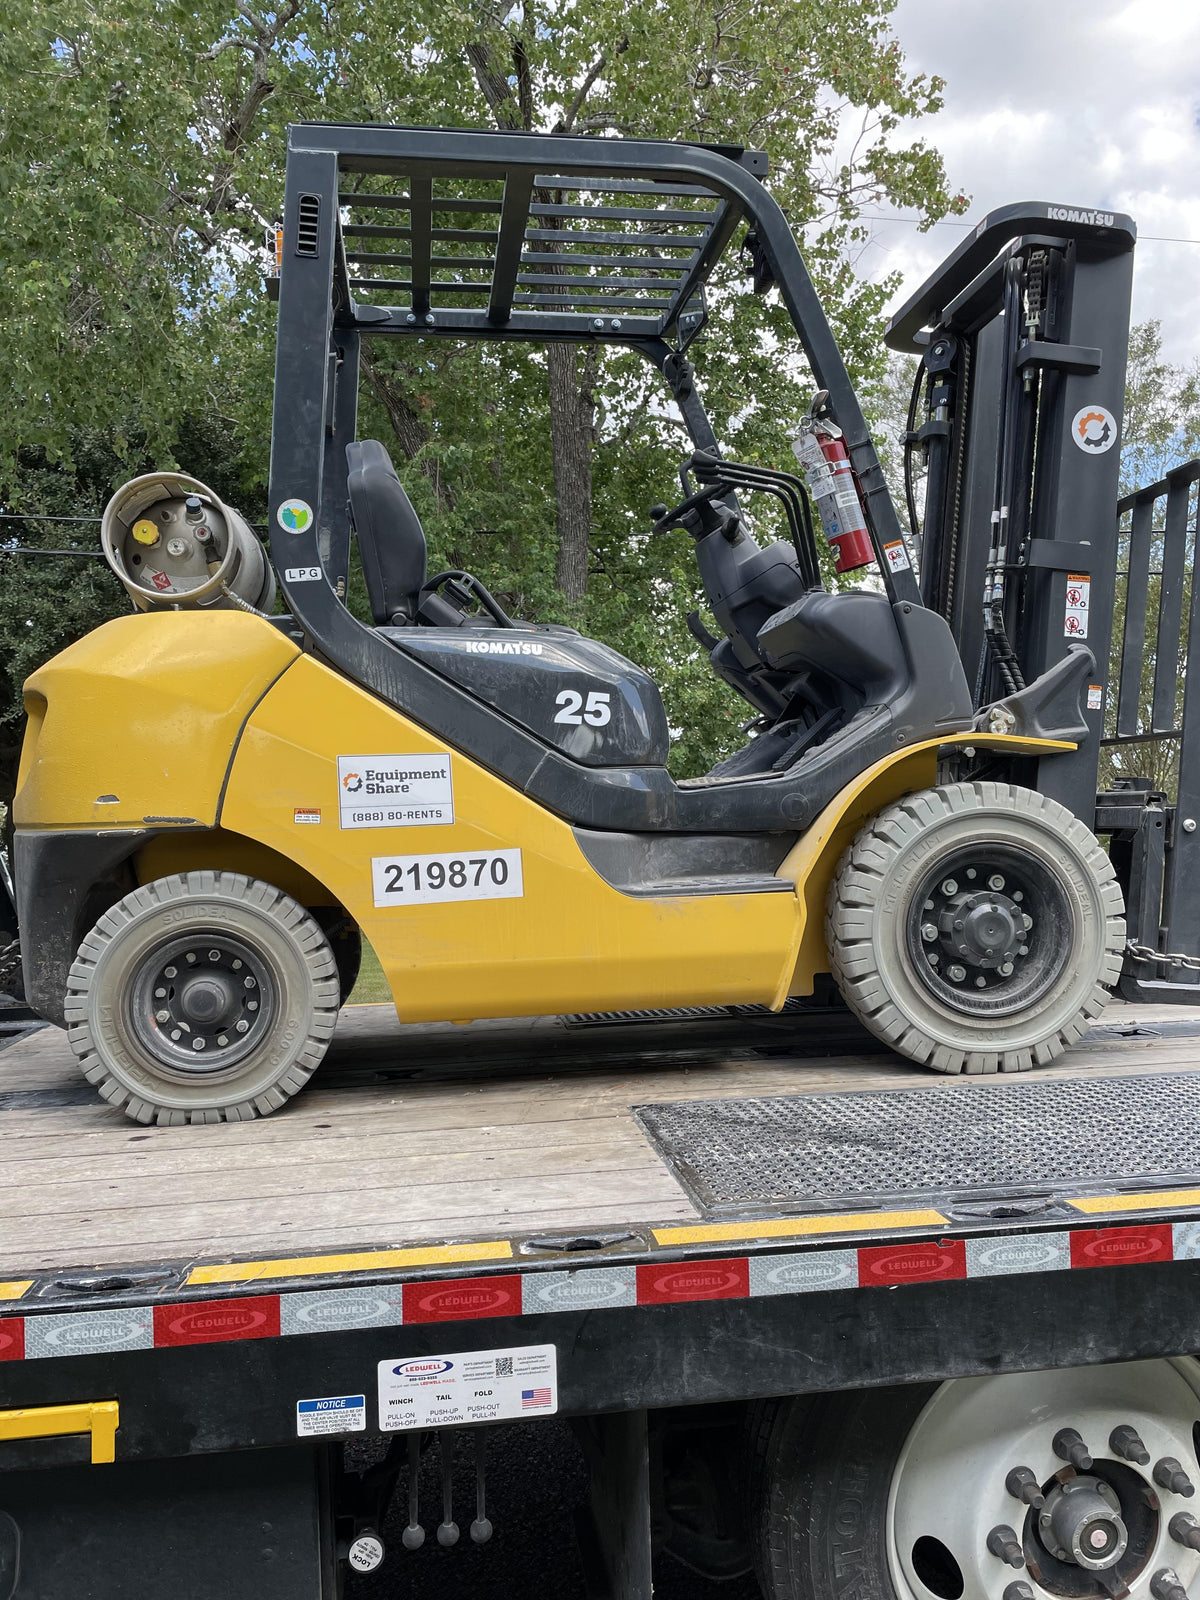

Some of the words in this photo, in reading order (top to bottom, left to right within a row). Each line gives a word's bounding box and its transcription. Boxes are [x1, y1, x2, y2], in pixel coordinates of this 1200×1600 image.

[1048, 207, 1114, 226] KOMATSU
[466, 641, 543, 656] KOMATSU
[554, 690, 612, 727] 25
[366, 769, 447, 784] Equipment
[352, 812, 384, 822] (888)
[388, 810, 443, 820] 80-RENTS
[384, 857, 509, 893] 219870
[1100, 1242, 1148, 1252] LEDWELL
[888, 1258, 938, 1270] LEDWELL
[784, 1267, 836, 1279] LEDWELL
[672, 1276, 724, 1288] LEDWELL
[438, 1294, 492, 1307] LEDWELL
[316, 1304, 372, 1318] LEDWELL
[190, 1316, 249, 1328] LEDWELL
[405, 1364, 442, 1372] LEDWELL
[316, 1400, 346, 1410] NOTICE
[467, 1403, 500, 1412] PUSH-OUT
[430, 1408, 459, 1416] PUSH-UP
[385, 1420, 418, 1428] PUSH-OFF
[426, 1415, 464, 1423] PULL-DOWN
[352, 1554, 370, 1568] LOCK
